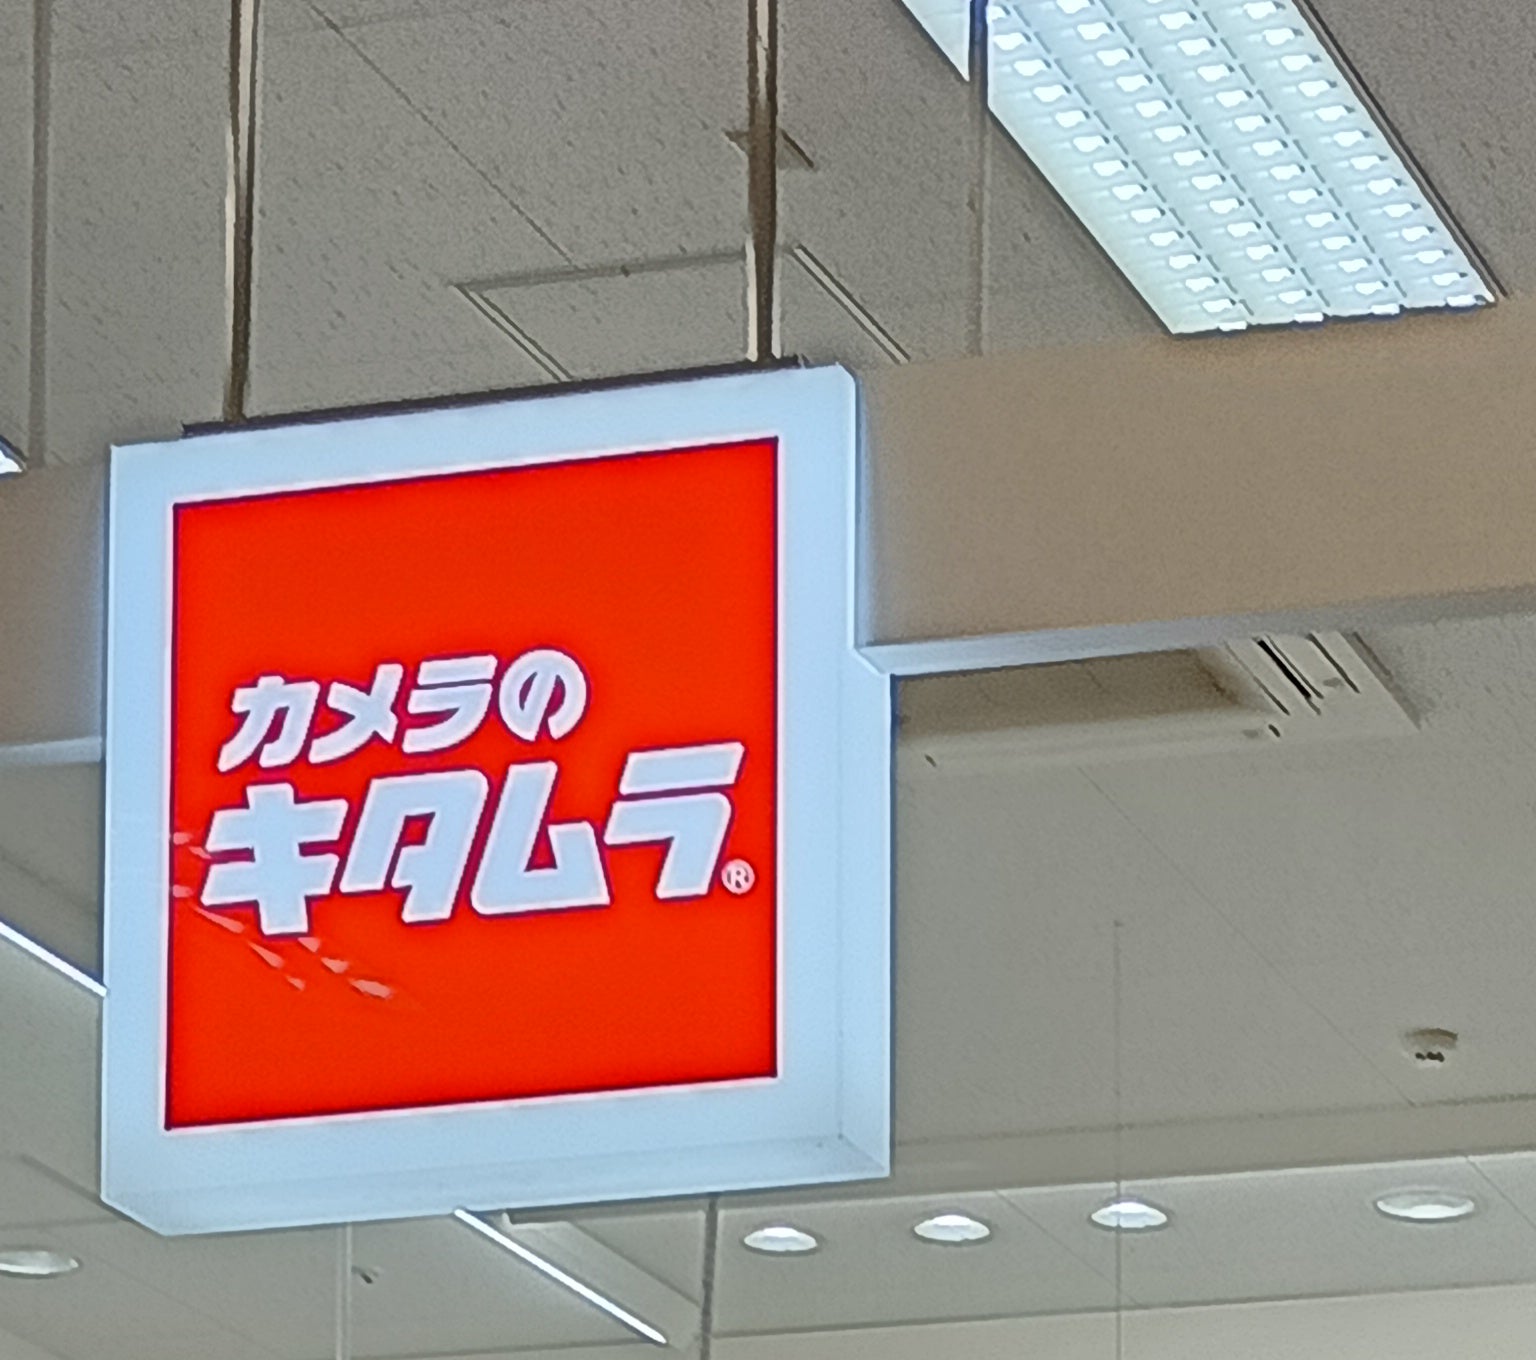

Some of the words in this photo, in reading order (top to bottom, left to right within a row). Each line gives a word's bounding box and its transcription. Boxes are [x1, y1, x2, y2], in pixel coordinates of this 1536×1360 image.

[218, 648, 588, 772] カメラの
[200, 742, 747, 936] キタムラ
